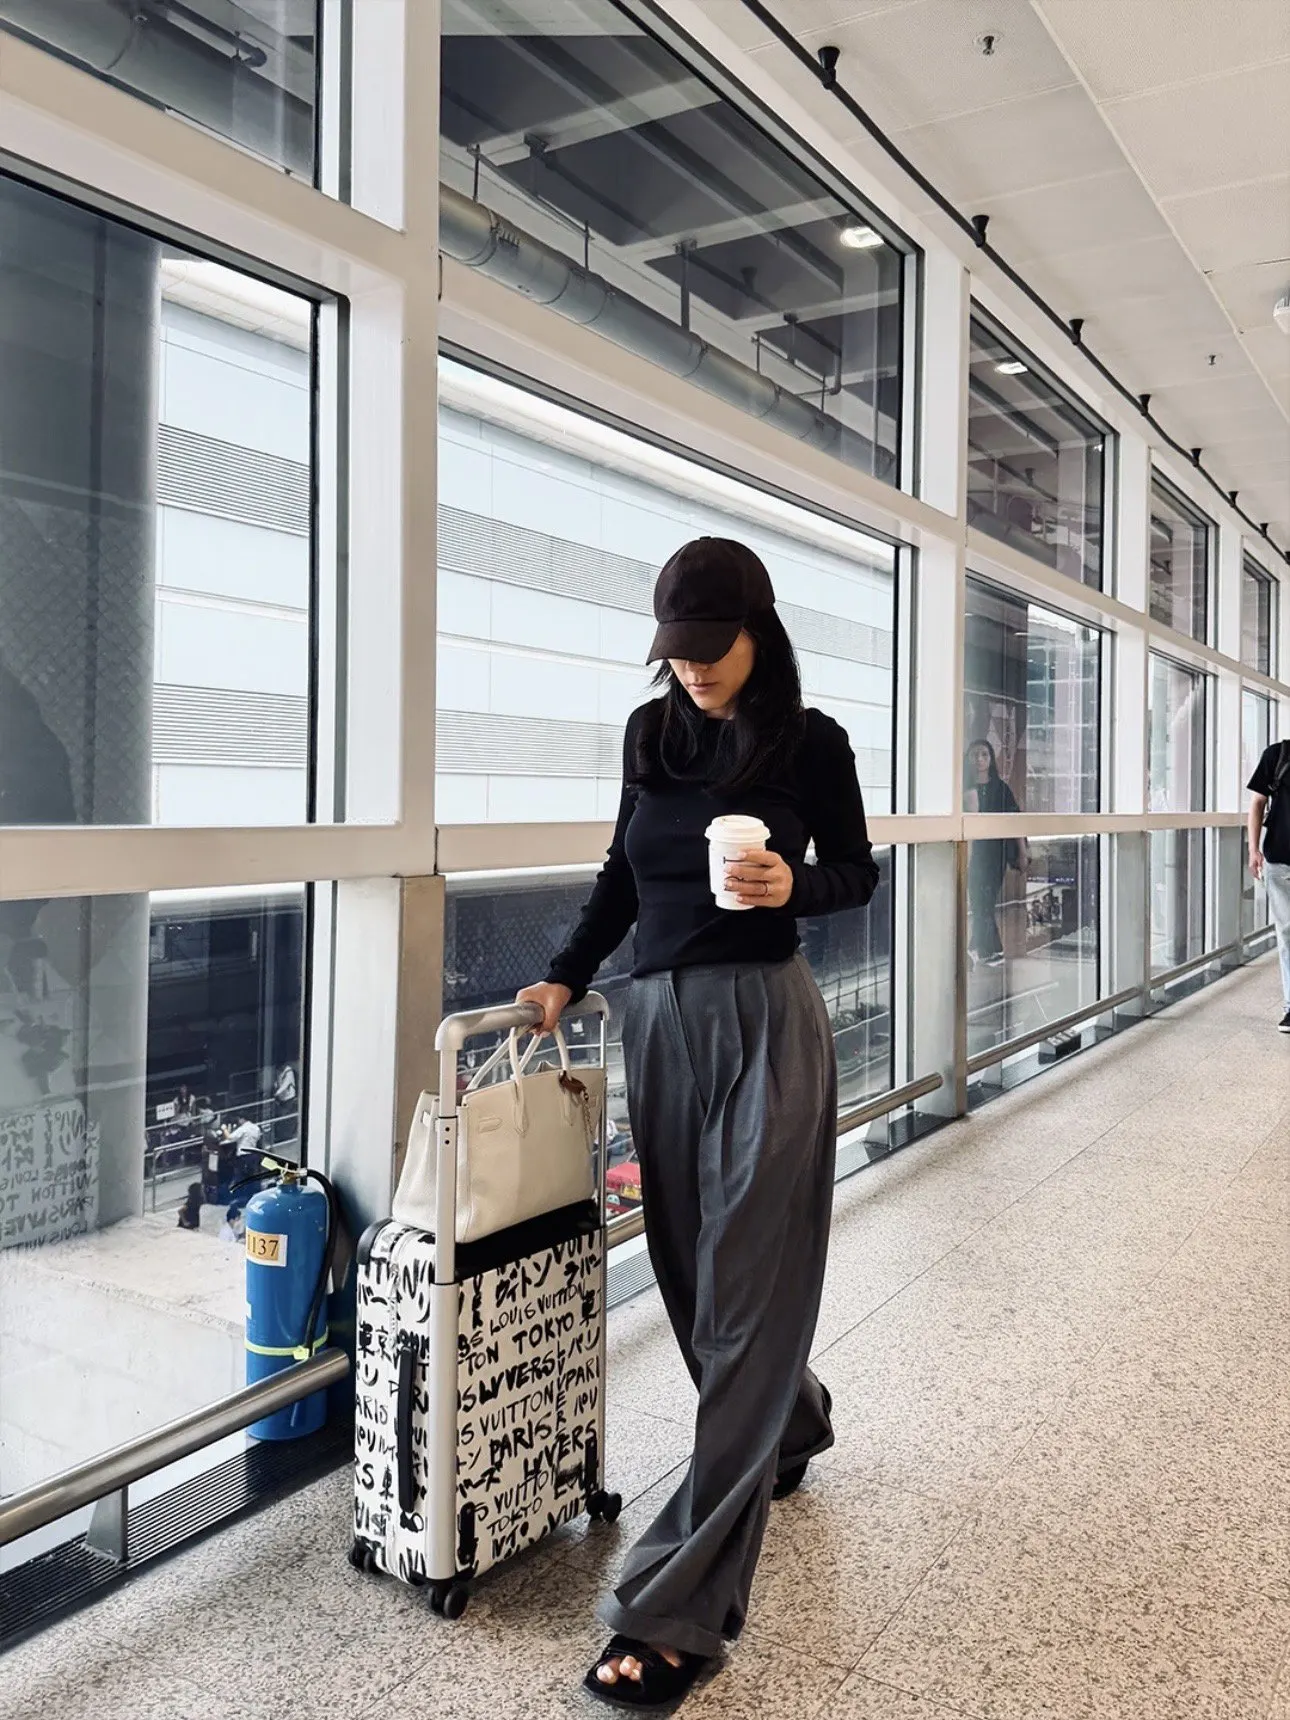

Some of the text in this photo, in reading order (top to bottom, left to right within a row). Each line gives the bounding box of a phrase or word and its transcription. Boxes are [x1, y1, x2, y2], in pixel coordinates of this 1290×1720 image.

[490, 1302, 536, 1336] LOUIS
[512, 1312, 574, 1354] TOKYO
[480, 1380, 554, 1436] VUITTON
[489, 1412, 552, 1466] PARIS
